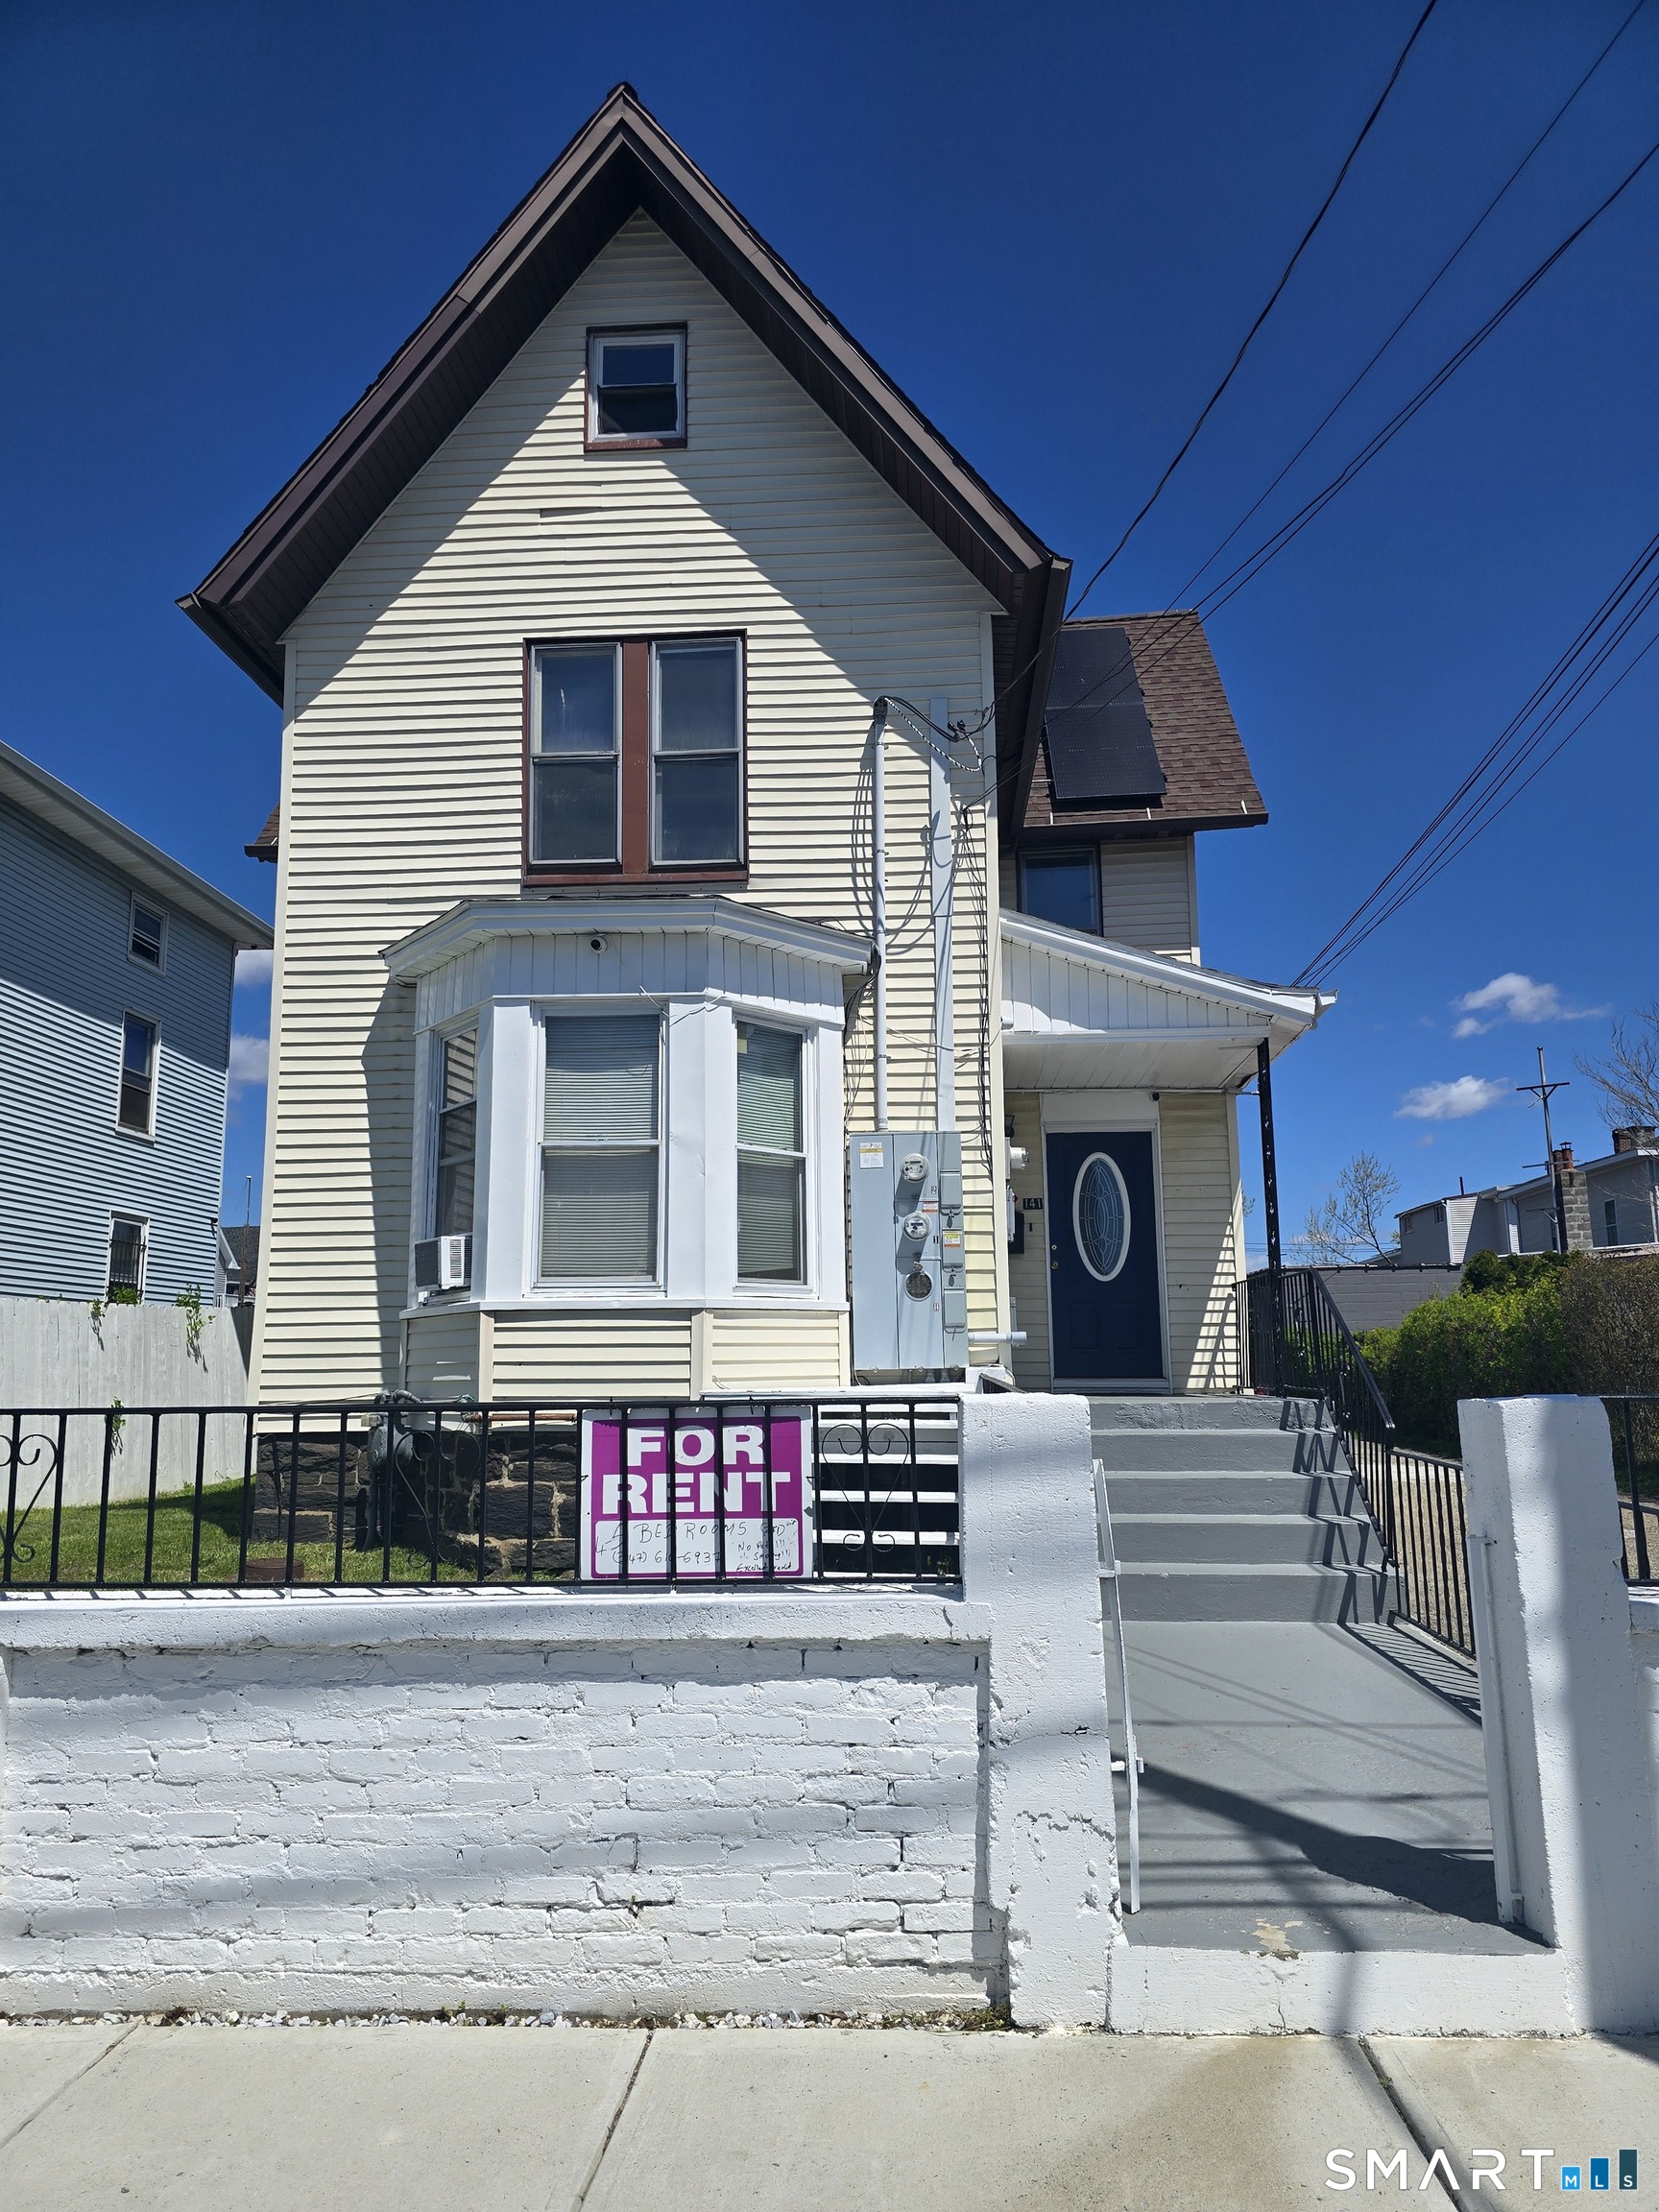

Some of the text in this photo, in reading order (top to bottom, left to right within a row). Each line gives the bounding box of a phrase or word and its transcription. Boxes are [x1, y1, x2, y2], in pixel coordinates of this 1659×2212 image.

[1024, 1198, 1042, 1208] 141
[627, 1425, 765, 1466] FOR
[602, 1472, 791, 1514] RENT
